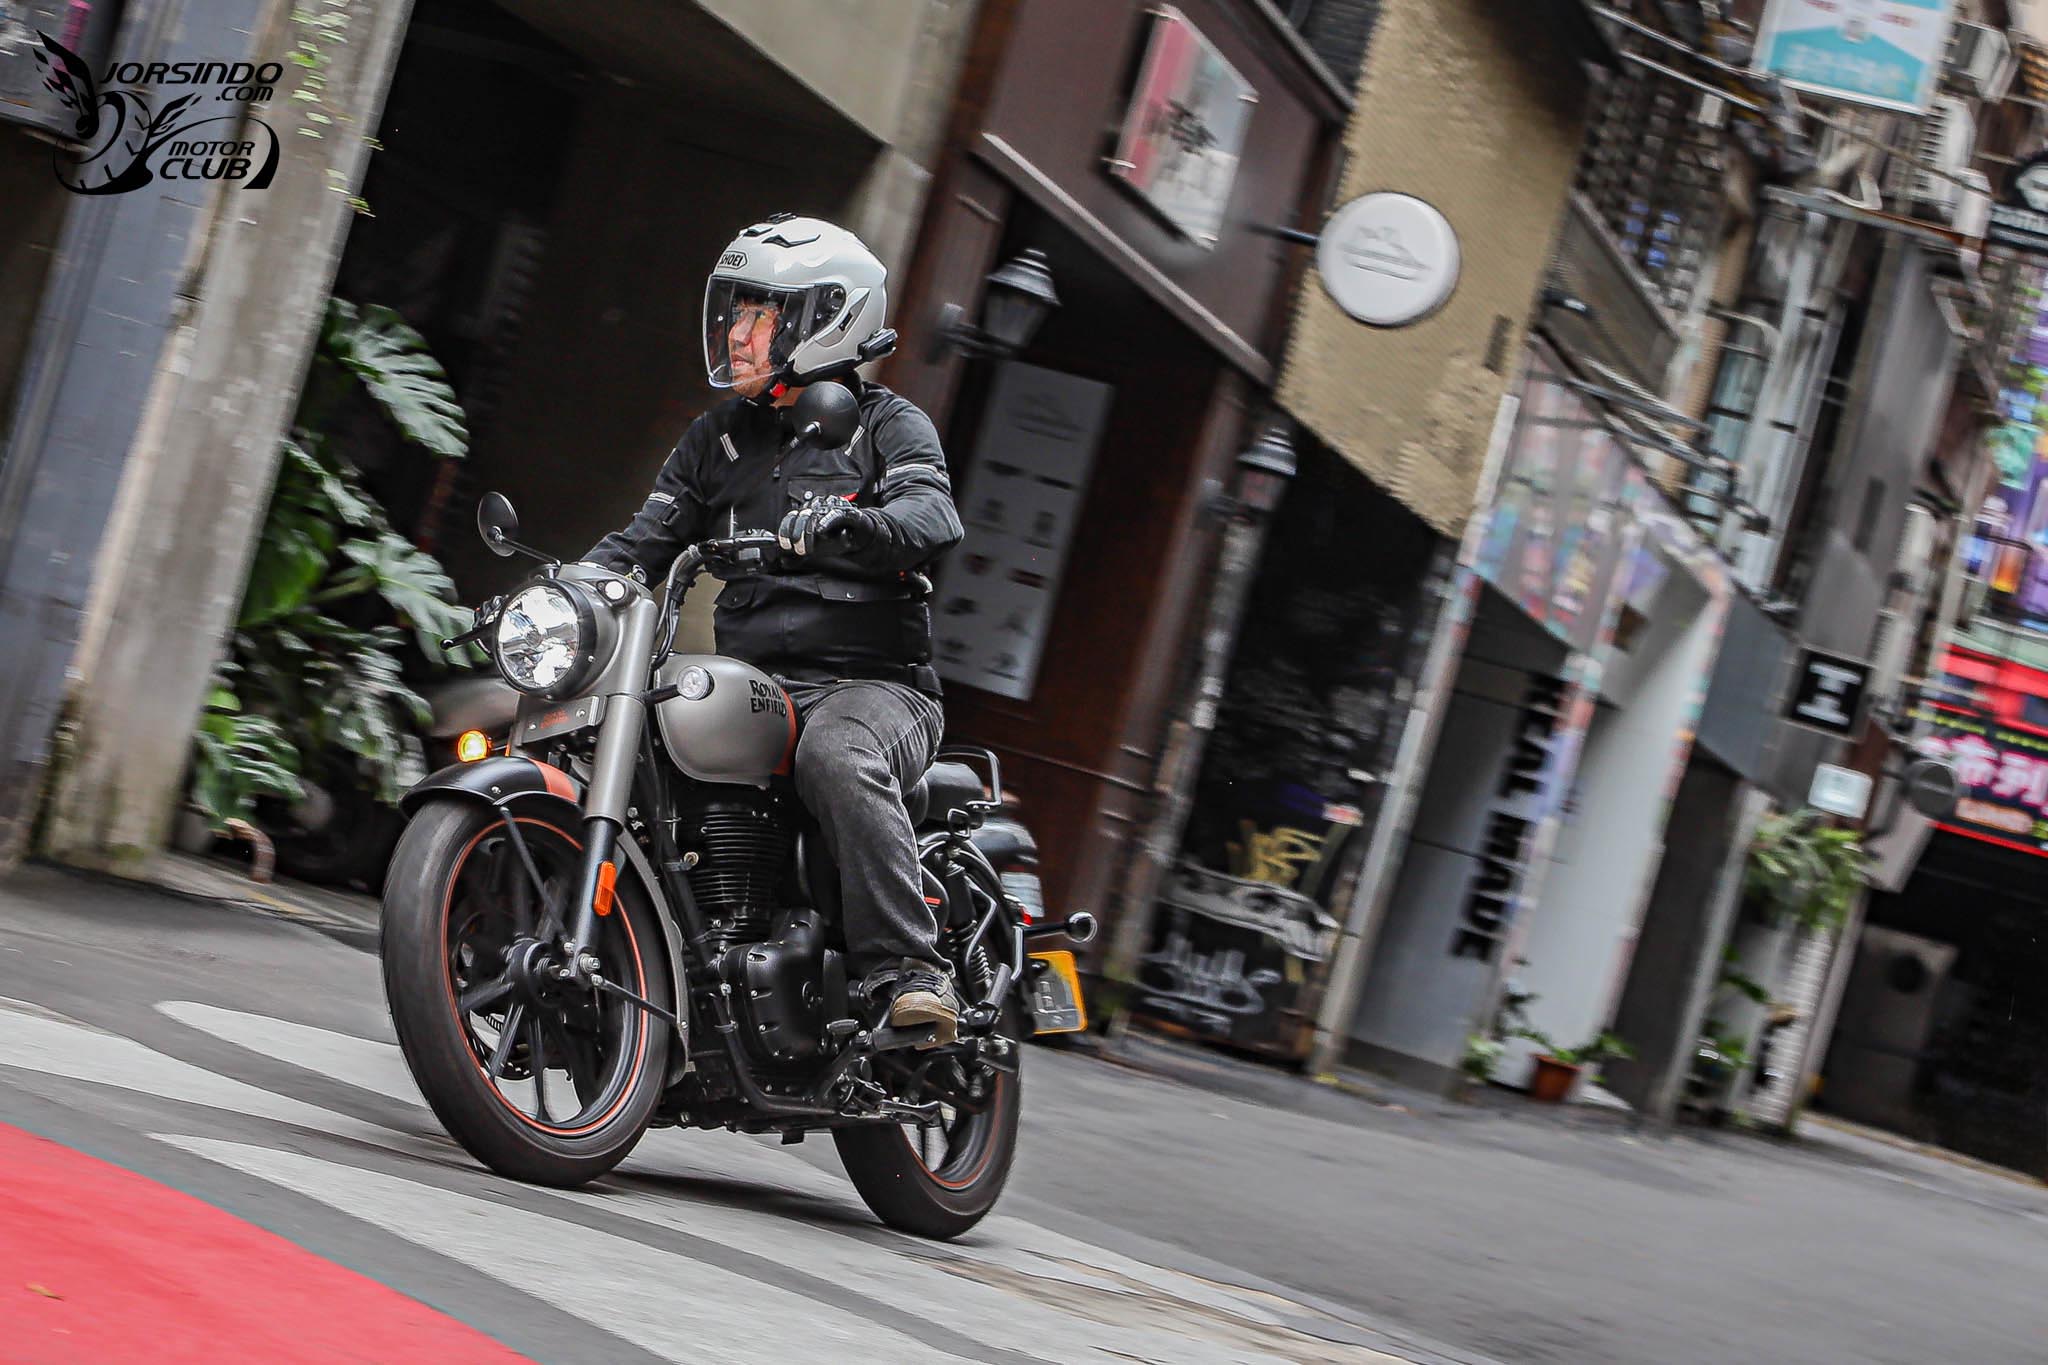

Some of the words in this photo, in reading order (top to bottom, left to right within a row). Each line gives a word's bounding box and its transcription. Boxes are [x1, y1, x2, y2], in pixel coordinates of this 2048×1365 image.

[719, 253, 744, 267] SHOEI
[749, 679, 782, 700] ROYAL
[750, 697, 787, 718] ENFIELD
